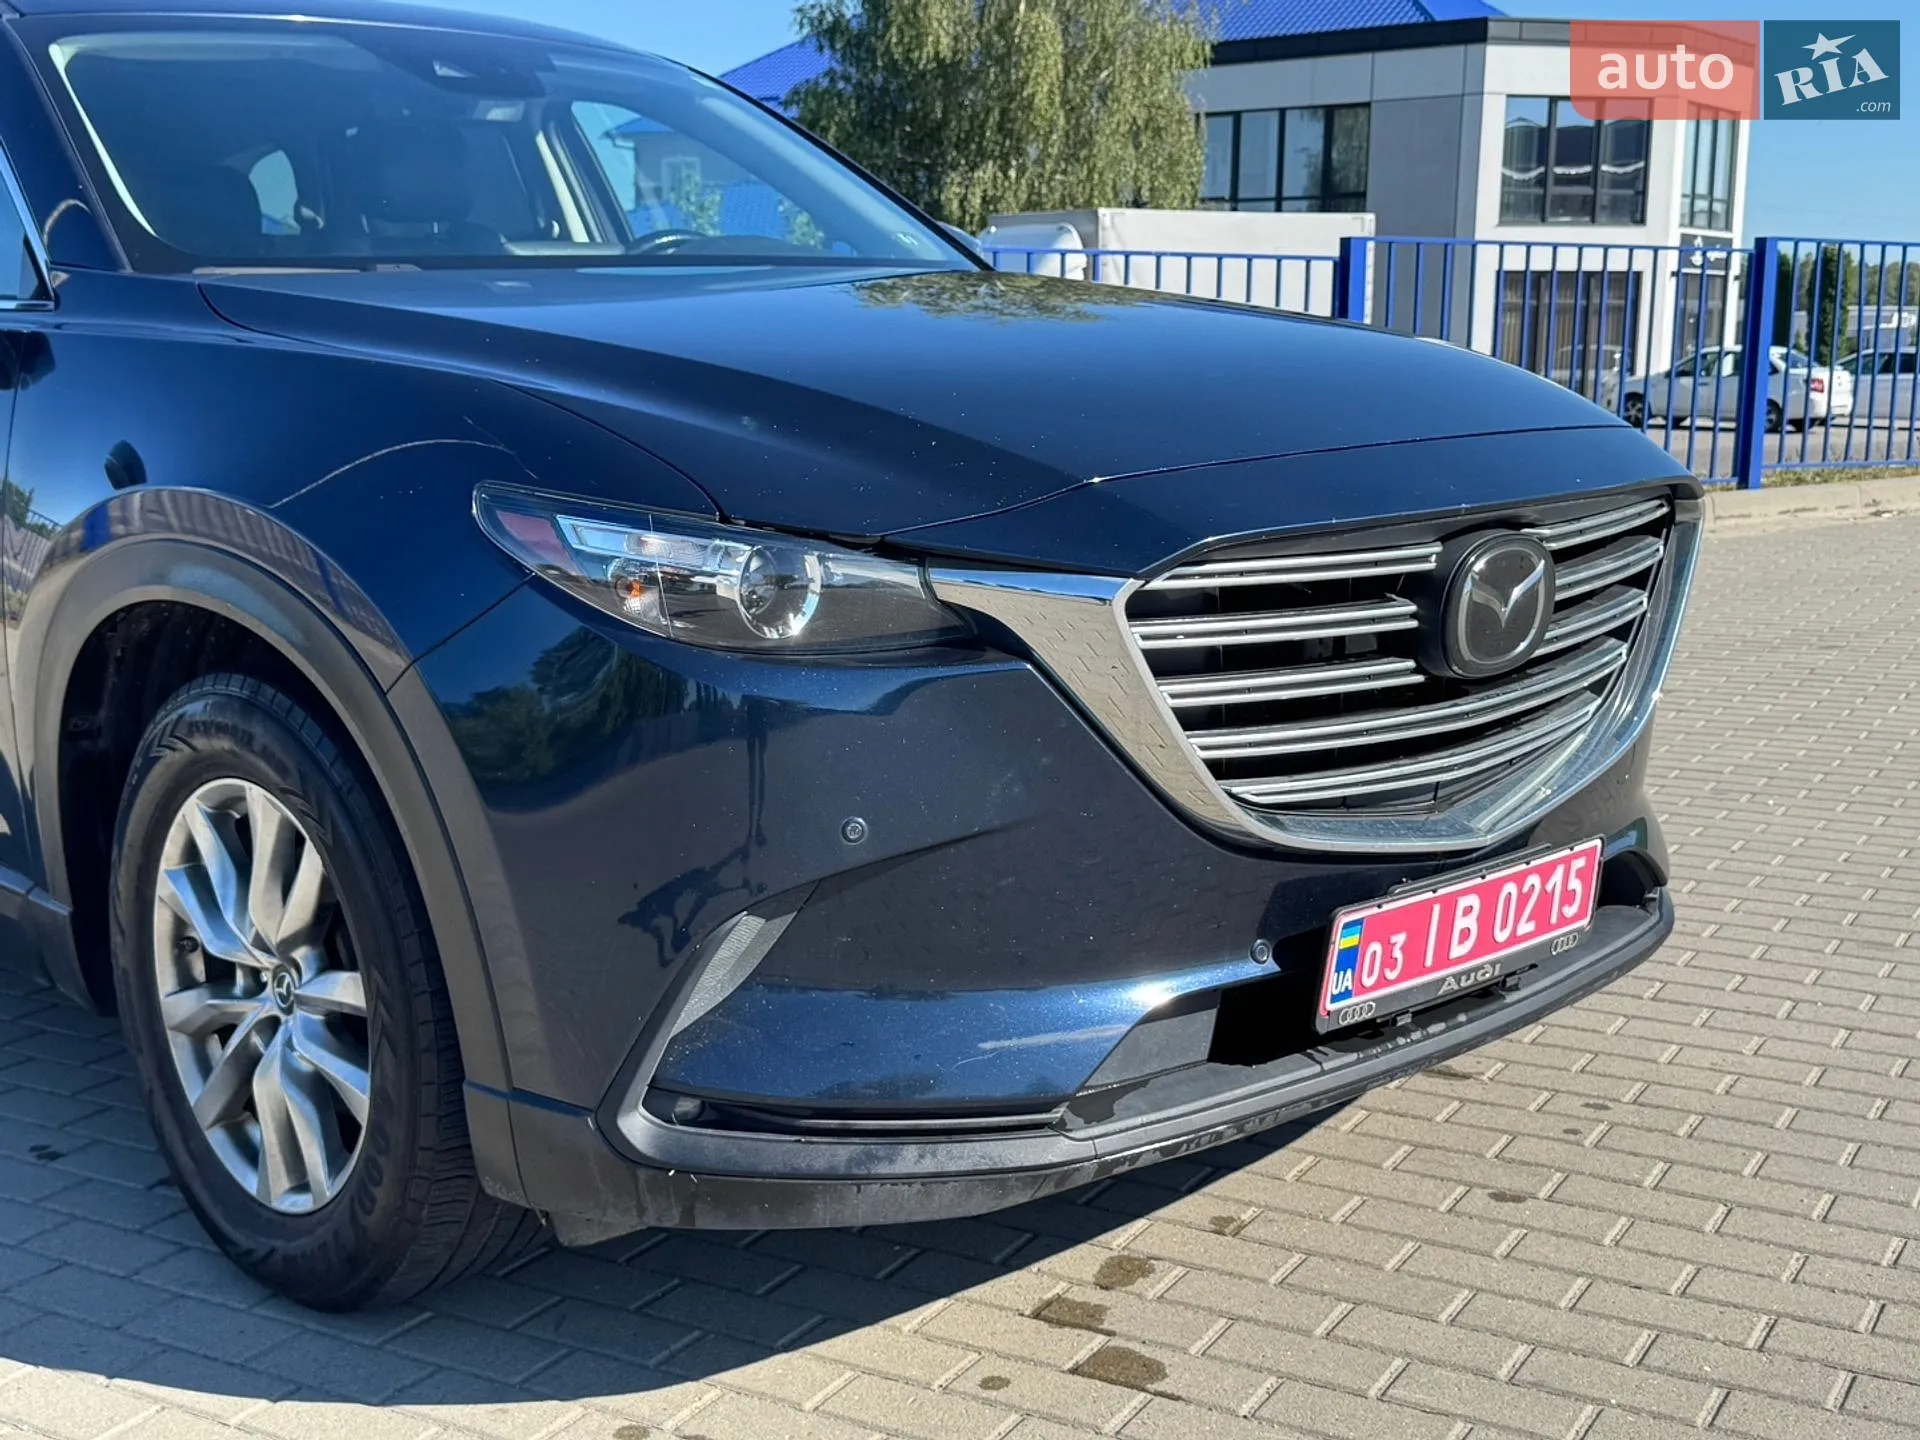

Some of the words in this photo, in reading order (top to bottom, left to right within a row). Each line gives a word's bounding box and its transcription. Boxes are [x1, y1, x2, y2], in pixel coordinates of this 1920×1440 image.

[1361, 931, 1407, 988] 03
[1493, 856, 1587, 943] 0215
[1332, 969, 1353, 994] UA
[1437, 964, 1501, 995] Audi
